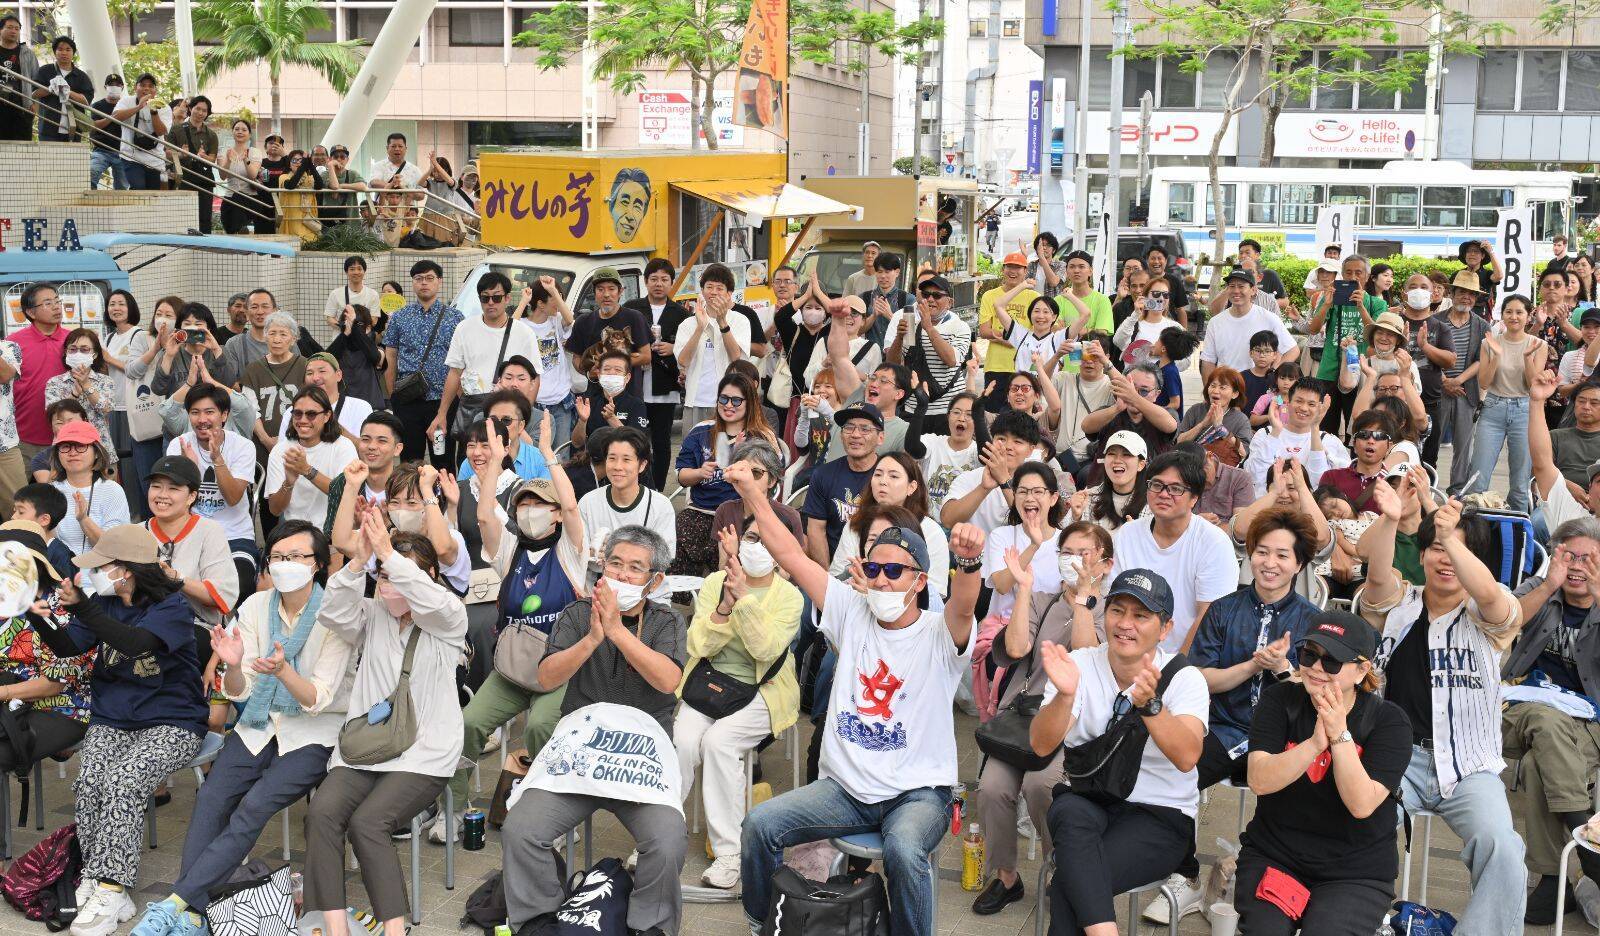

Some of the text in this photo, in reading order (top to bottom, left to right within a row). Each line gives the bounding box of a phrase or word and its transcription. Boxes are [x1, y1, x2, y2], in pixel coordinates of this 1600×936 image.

[642, 93, 668, 103] Cash
[643, 104, 691, 115] Exchange
[1360, 132, 1400, 144] e-Life!
[484, 171, 595, 239] みとしの芋
[1447, 674, 1483, 689] KINGS
[597, 754, 663, 778] ALL IN FOR
